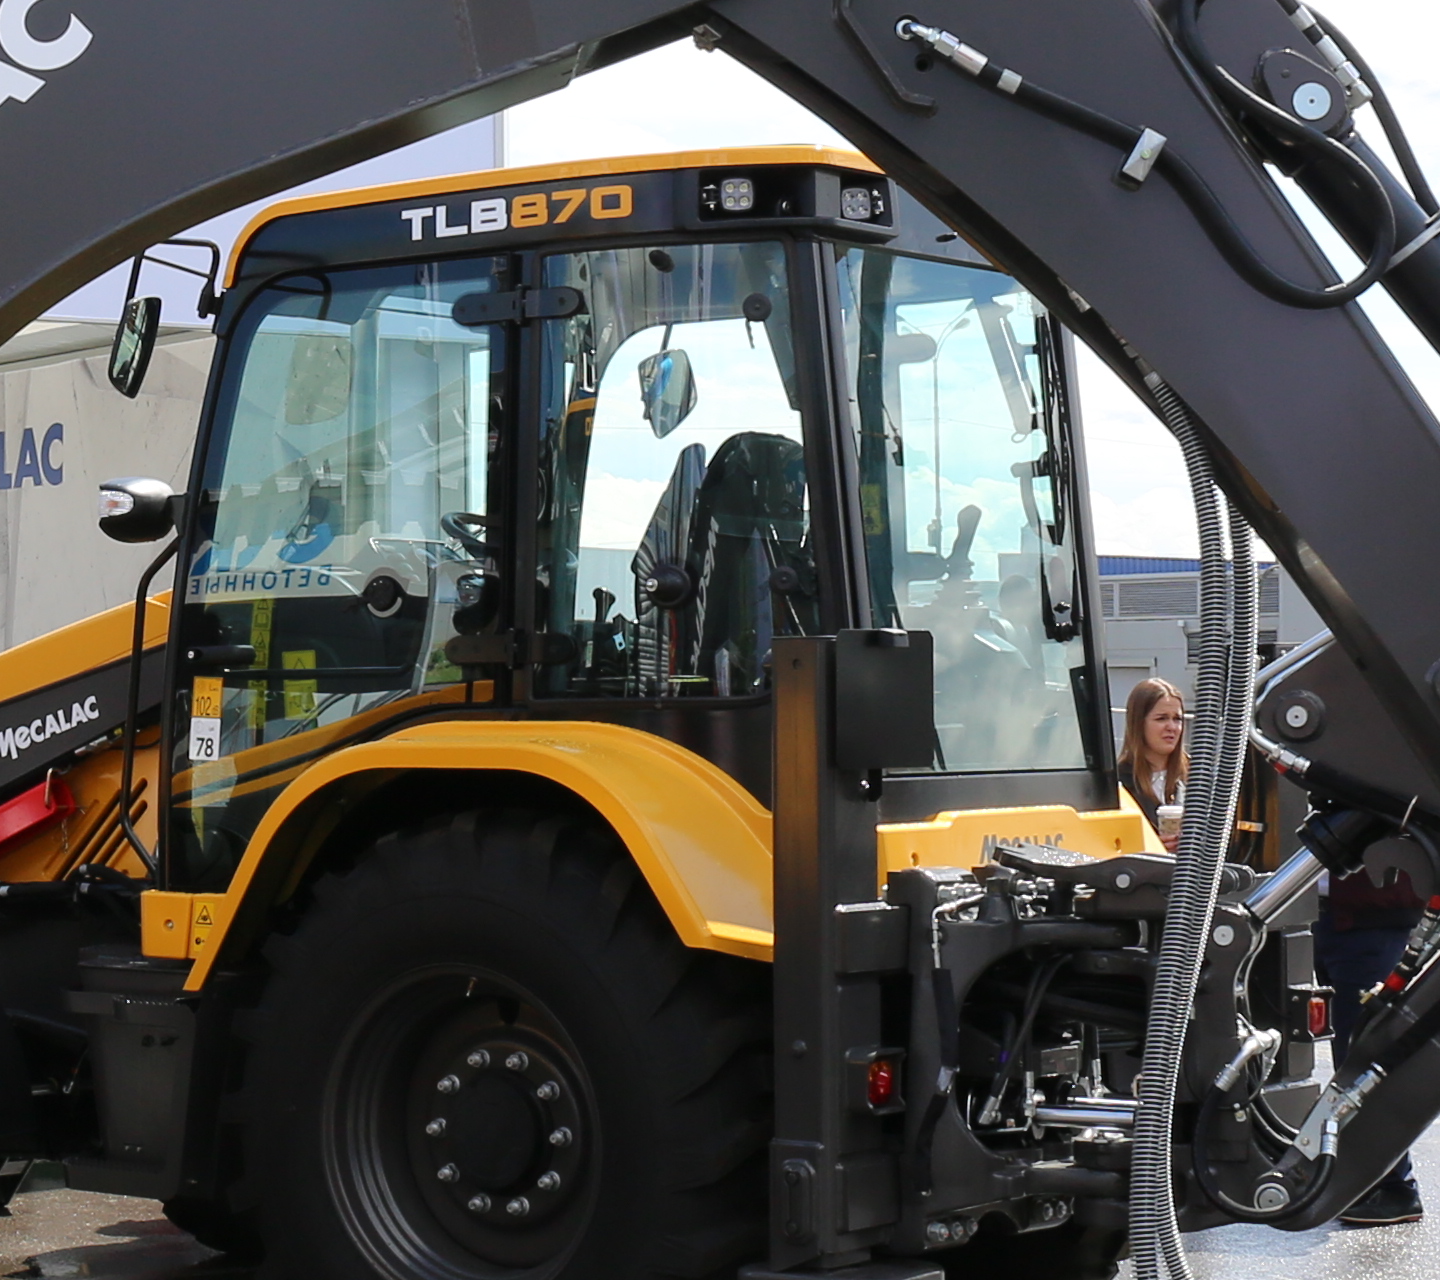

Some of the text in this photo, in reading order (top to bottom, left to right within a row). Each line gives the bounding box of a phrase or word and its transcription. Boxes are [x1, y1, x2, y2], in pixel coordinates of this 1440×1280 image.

[401, 185, 633, 241] TLB870
[195, 696, 212, 716] 102
[196, 737, 214, 758] 78
